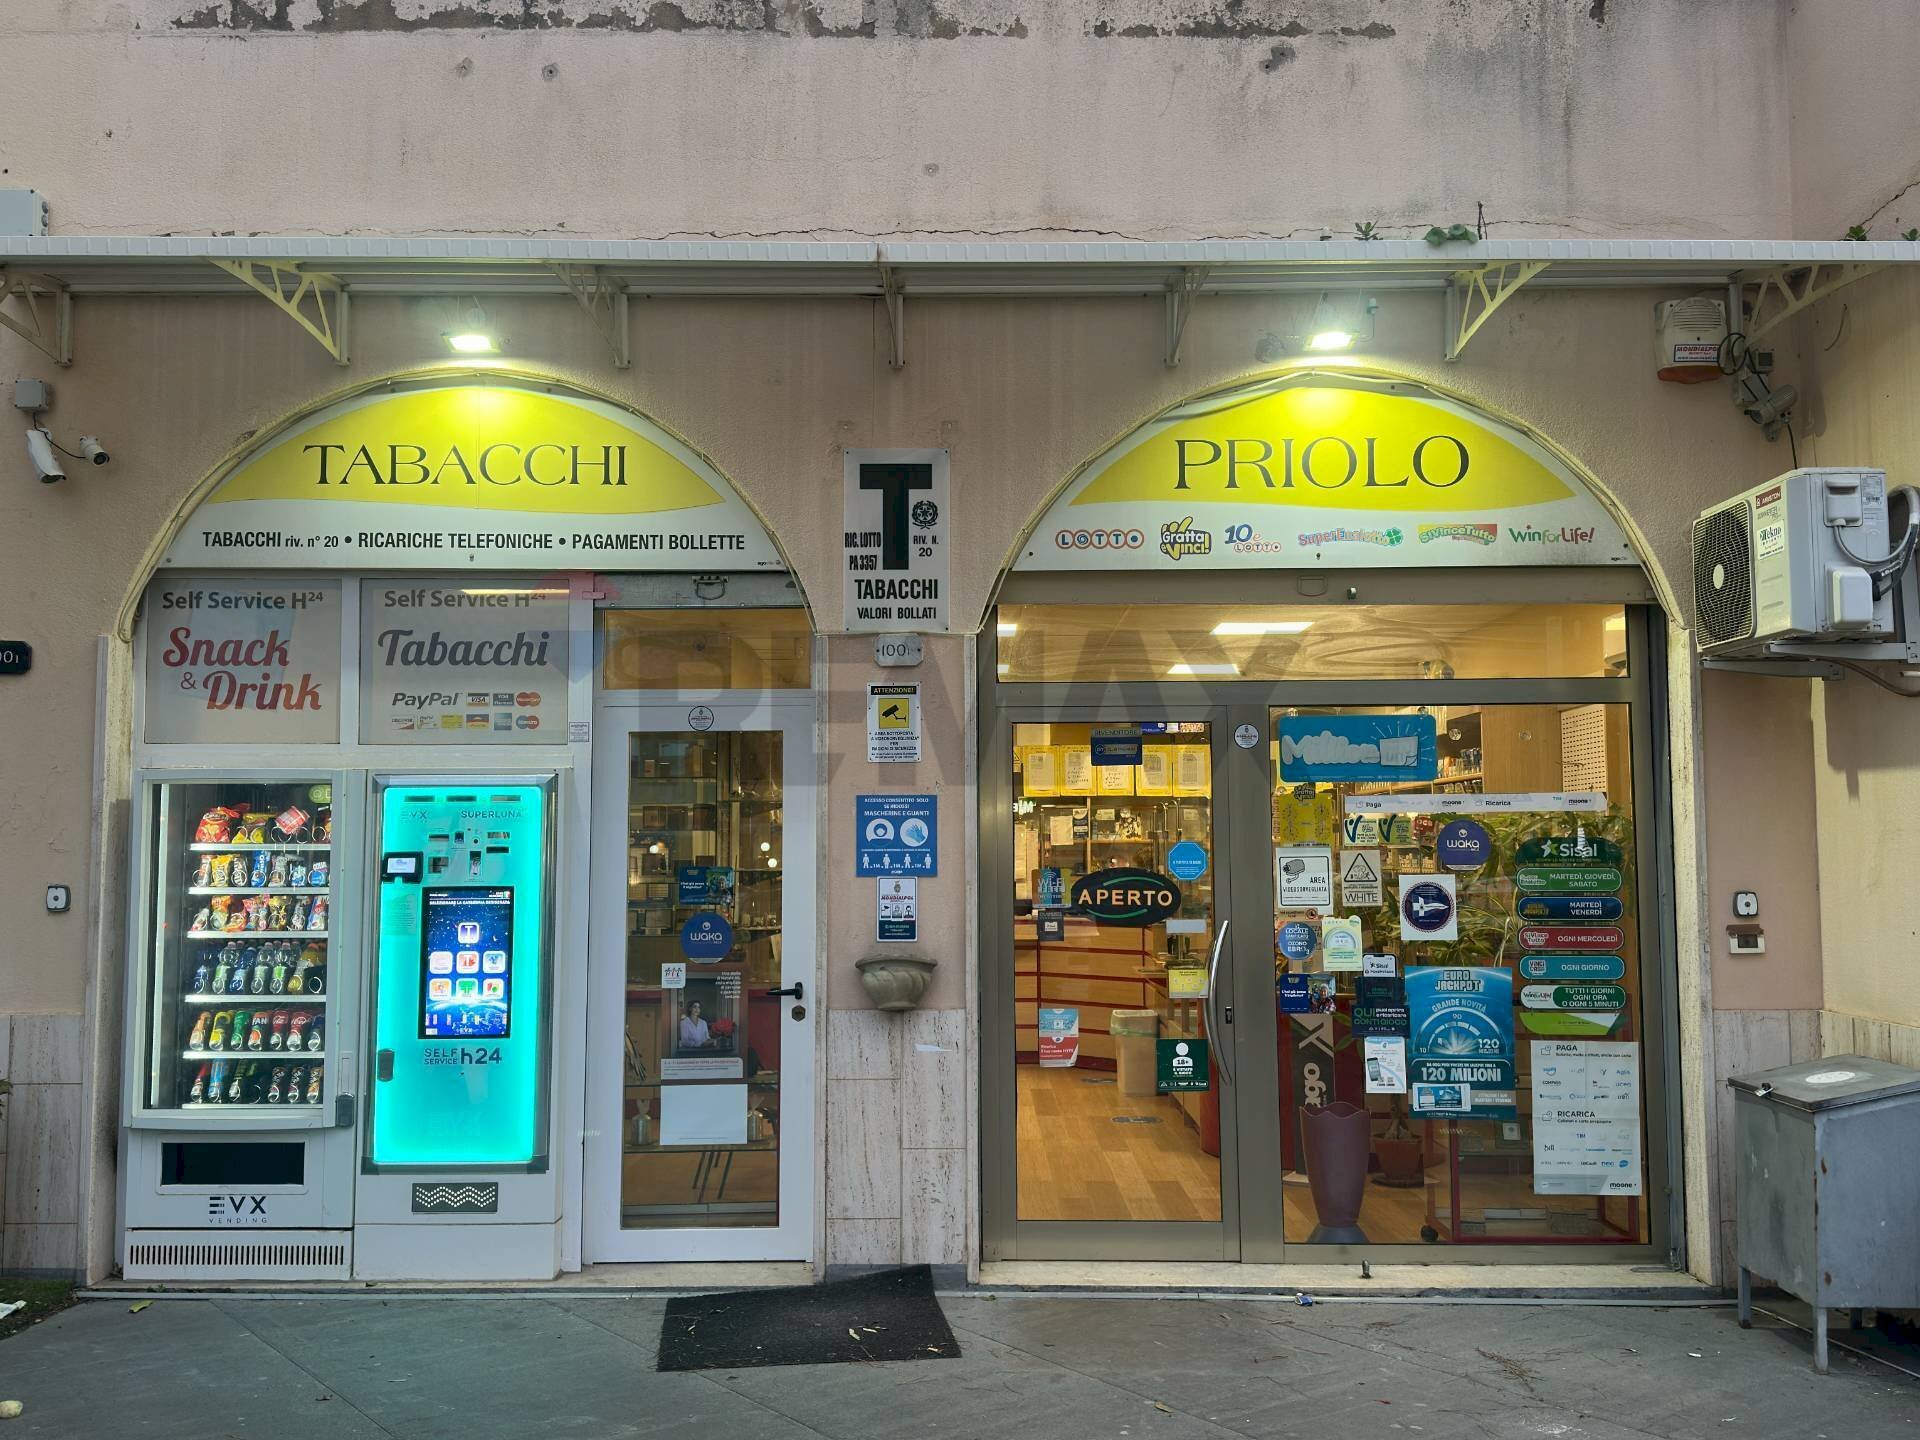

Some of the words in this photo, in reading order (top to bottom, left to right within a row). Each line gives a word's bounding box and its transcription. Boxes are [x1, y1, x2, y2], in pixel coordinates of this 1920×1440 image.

[303, 444, 628, 485] TABACCHI
[1174, 436, 1469, 489] PRIOLO
[860, 464, 932, 570] T
[203, 532, 281, 548] TABACCHI
[285, 536, 304, 547] riv.
[324, 537, 339, 548] 20
[358, 533, 443, 548] RICARICHE
[448, 533, 552, 549] TELEFONICHE
[572, 534, 664, 550] PAGAMENTI
[669, 535, 745, 550] BOLLETTE
[860, 532, 881, 548] LOTTO
[1056, 529, 1144, 549] LOTTO
[1162, 531, 1205, 543] Gratta
[1224, 523, 1253, 544] 10
[918, 548, 932, 557] 20
[1234, 542, 1281, 552] LOTTO
[854, 579, 938, 599] TABACCHI
[162, 591, 203, 609] Self
[208, 592, 286, 609] Service
[384, 589, 426, 608] Self
[430, 590, 508, 608] Service
[857, 607, 892, 619] VALORI
[897, 607, 936, 619] BOLLATI
[162, 627, 290, 667] Snack
[377, 629, 550, 666] Tabacchi
[180, 672, 198, 690] &
[202, 670, 323, 711] Drink
[392, 691, 460, 710] PayPal
[1560, 843, 1597, 857] Sisal
[1078, 889, 1173, 906] APERTO
[1344, 892, 1378, 902] WHITE
[1443, 969, 1470, 980] EURO
[1435, 980, 1481, 992] JACKPOT
[1353, 1007, 1376, 1018] QUI
[1431, 998, 1460, 1012] GRANDE
[1478, 1038, 1500, 1049] 120
[424, 1049, 458, 1058] SELF
[461, 1047, 502, 1064] h24
[1421, 1068, 1446, 1081] 120
[1450, 1068, 1502, 1082] MILIONI
[1557, 1110, 1596, 1118] RICARICA
[209, 1196, 267, 1214] EVX
